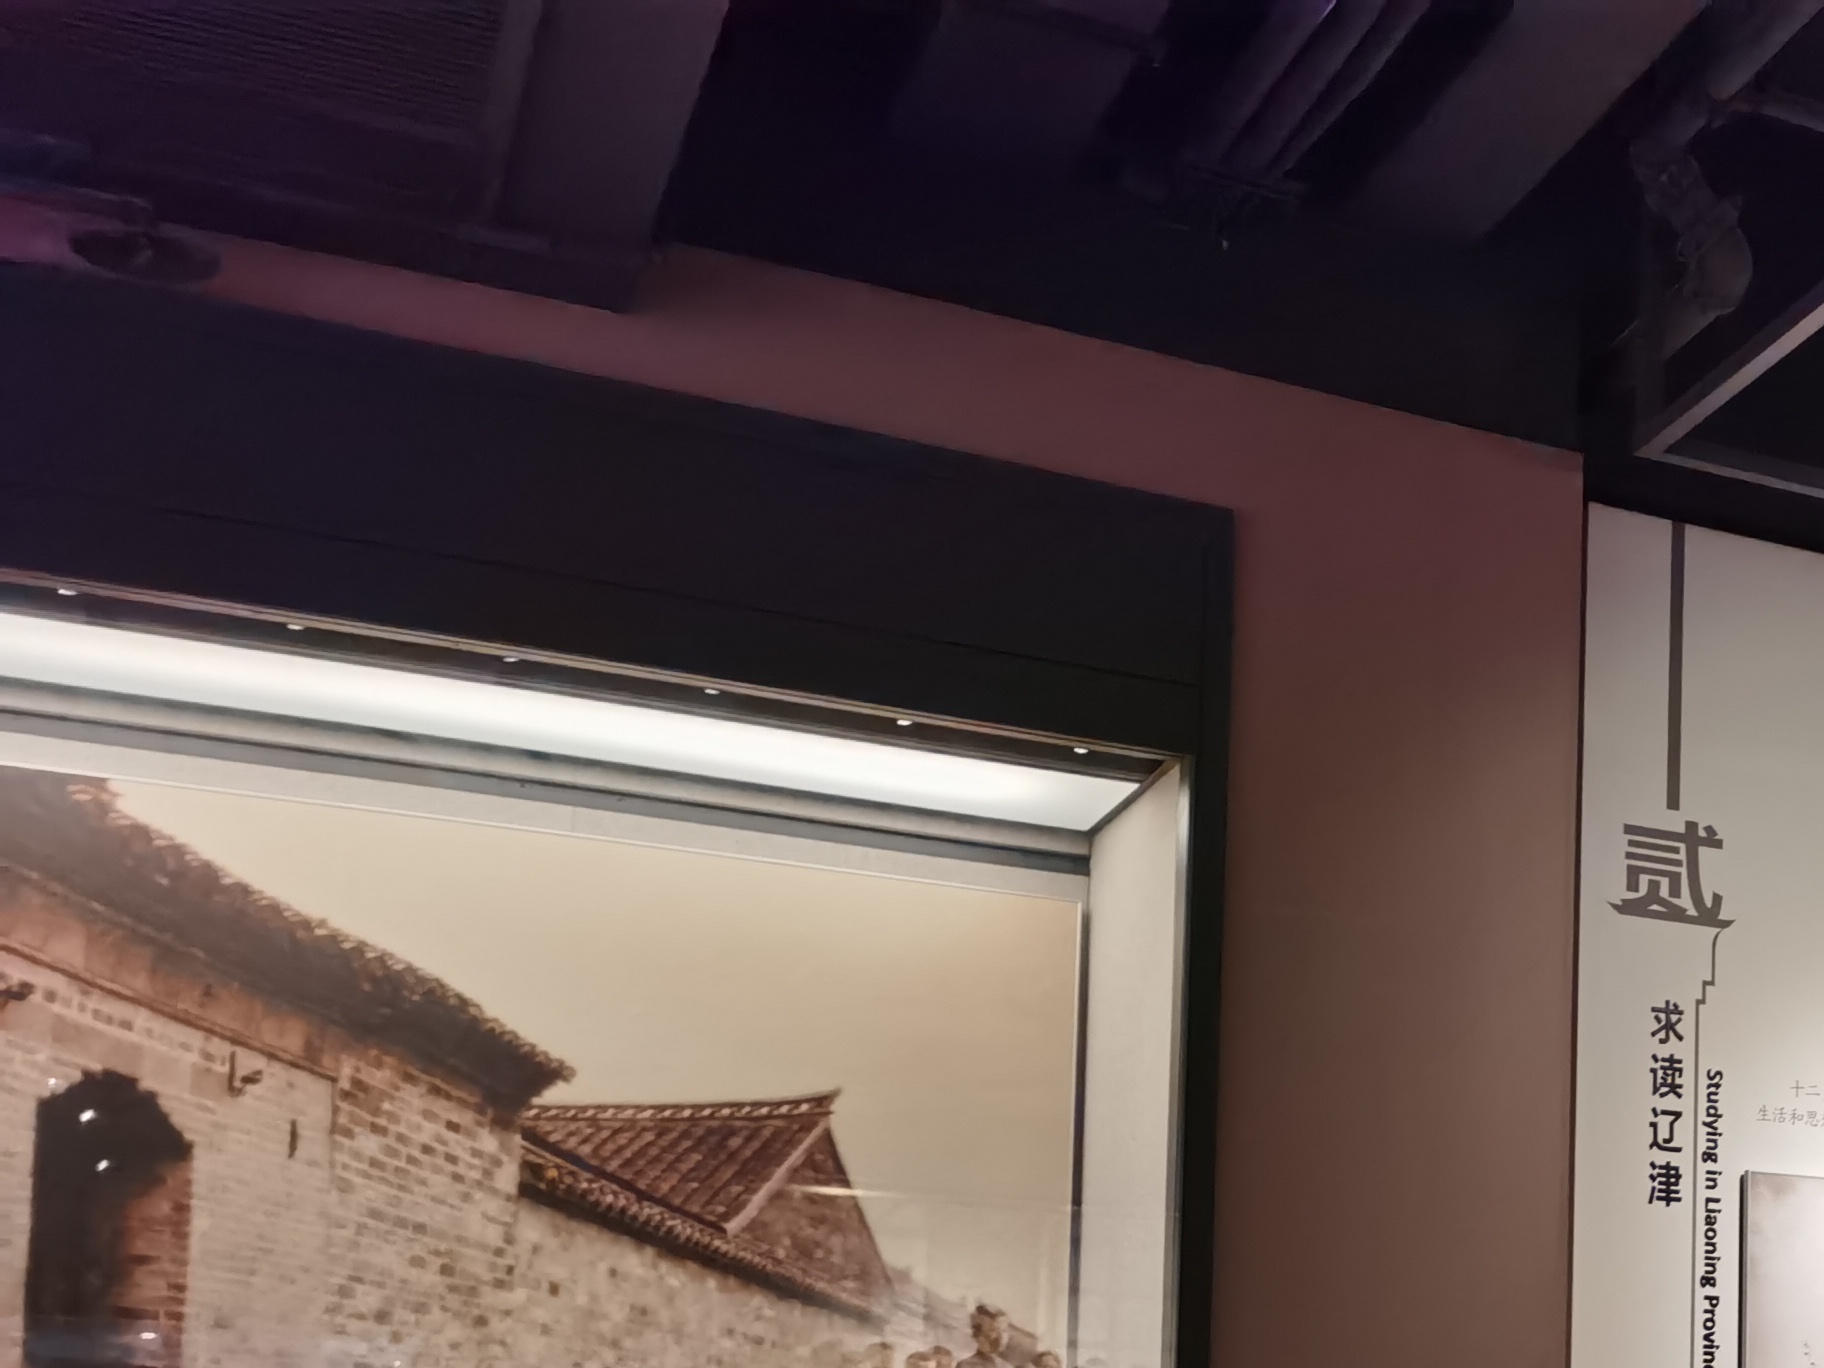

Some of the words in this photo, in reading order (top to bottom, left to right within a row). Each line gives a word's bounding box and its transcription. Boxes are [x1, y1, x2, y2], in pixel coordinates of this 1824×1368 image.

[1608, 820, 1736, 923] 贰
[1648, 1000, 1685, 1208] 求读辽津
[1701, 1068, 1724, 1165] Studying
[1704, 1169, 1723, 1191] in
[1700, 1196, 1723, 1289] Liaoning
